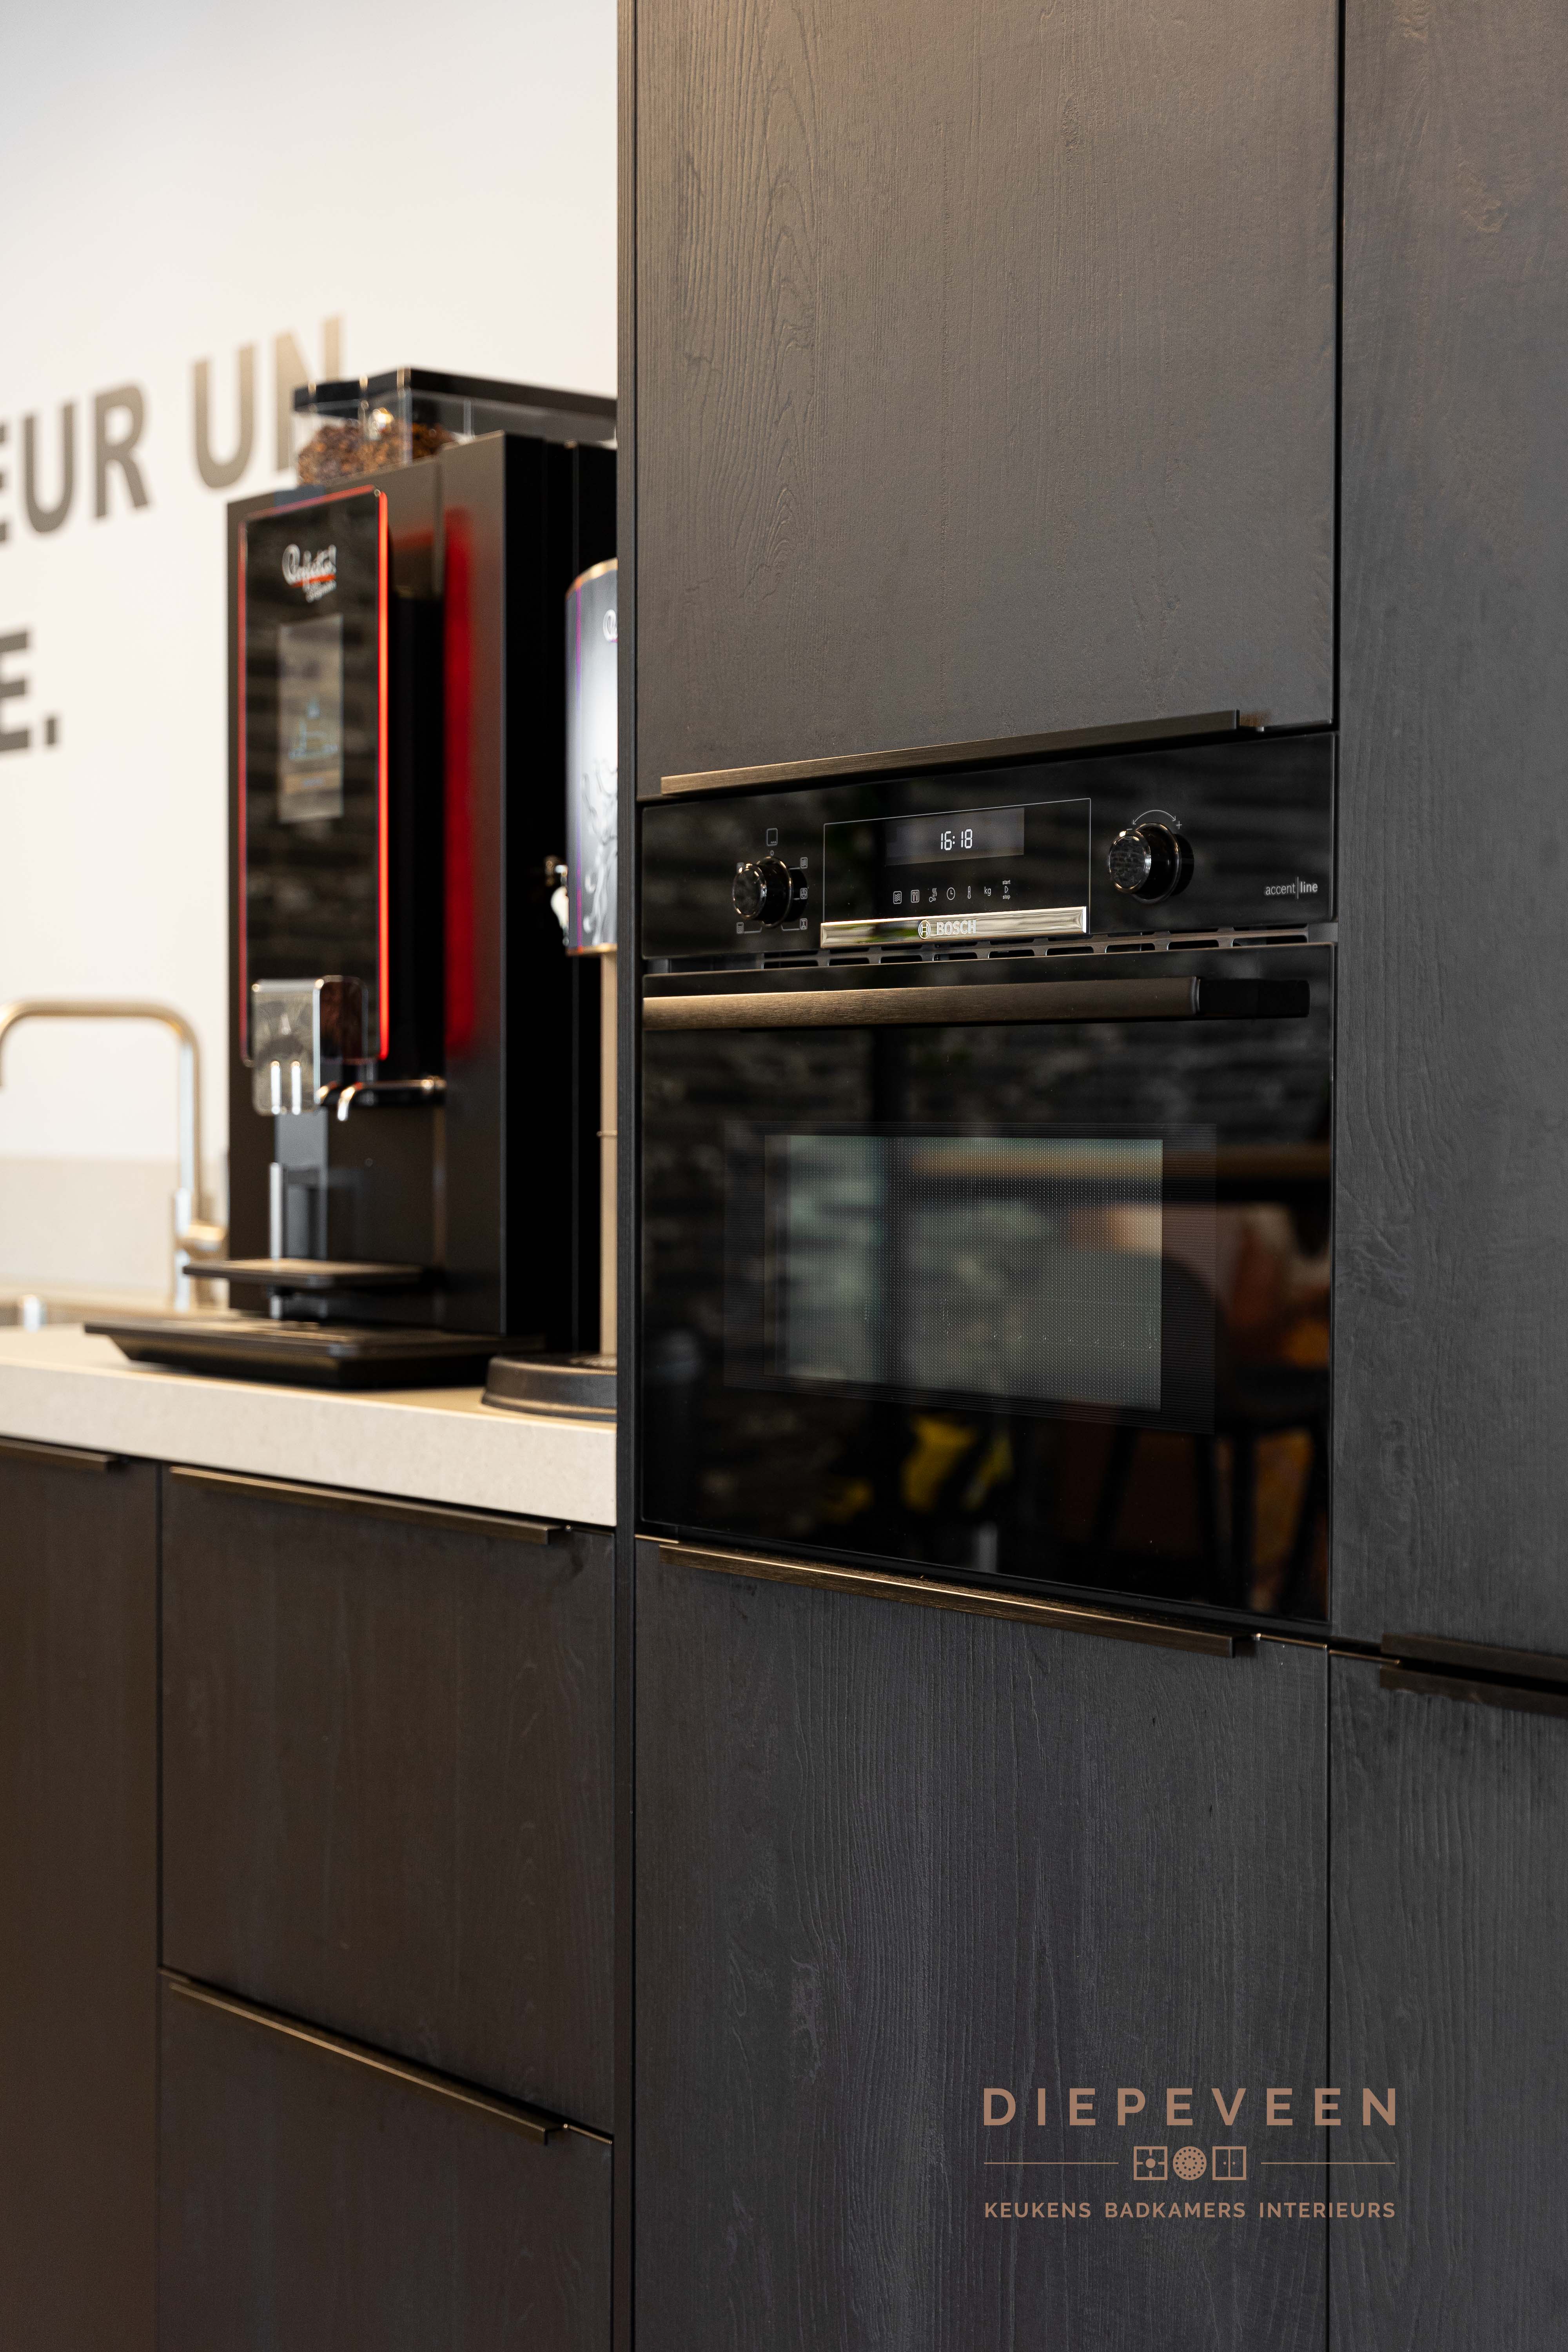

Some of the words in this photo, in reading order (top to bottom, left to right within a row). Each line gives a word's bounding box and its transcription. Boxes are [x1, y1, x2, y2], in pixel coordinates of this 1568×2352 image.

[941, 829, 973, 850] 16:18
[984, 886, 991, 896] kg
[936, 920, 976, 936] BOSCH
